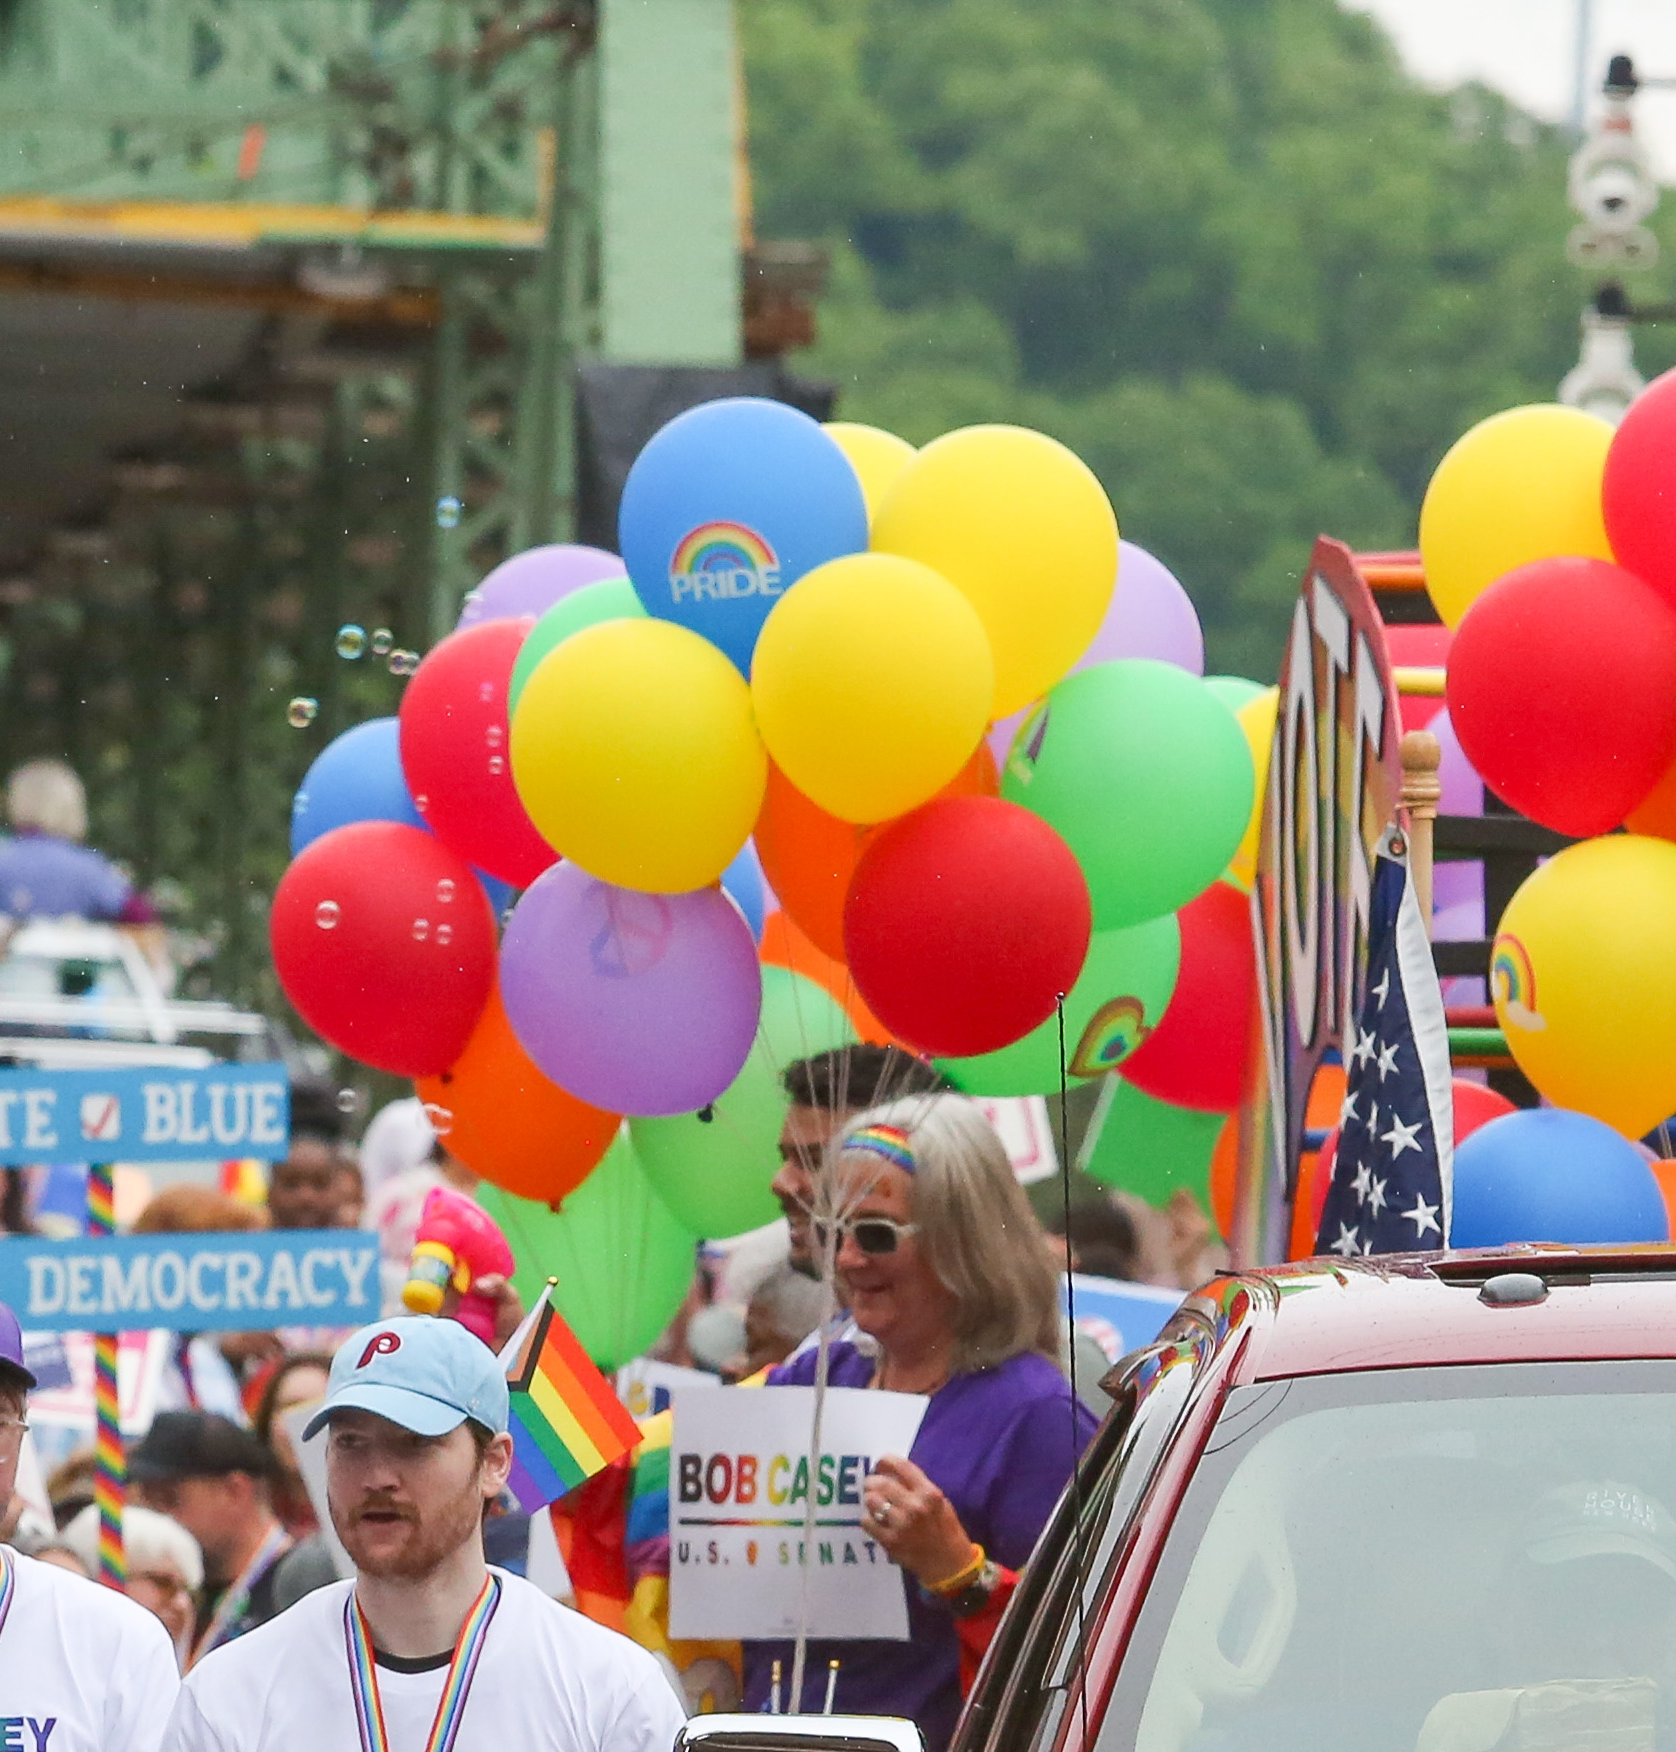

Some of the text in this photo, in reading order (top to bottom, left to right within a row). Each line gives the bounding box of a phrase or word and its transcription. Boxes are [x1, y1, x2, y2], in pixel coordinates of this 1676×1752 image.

[670, 564, 784, 604] PRIDE
[141, 1078, 286, 1145] BLUE
[27, 1249, 375, 1315] DEMOCRACY
[356, 1332, 401, 1370] P
[679, 1454, 759, 1505] BOB
[678, 1542, 897, 1565] U.S. SENAT
